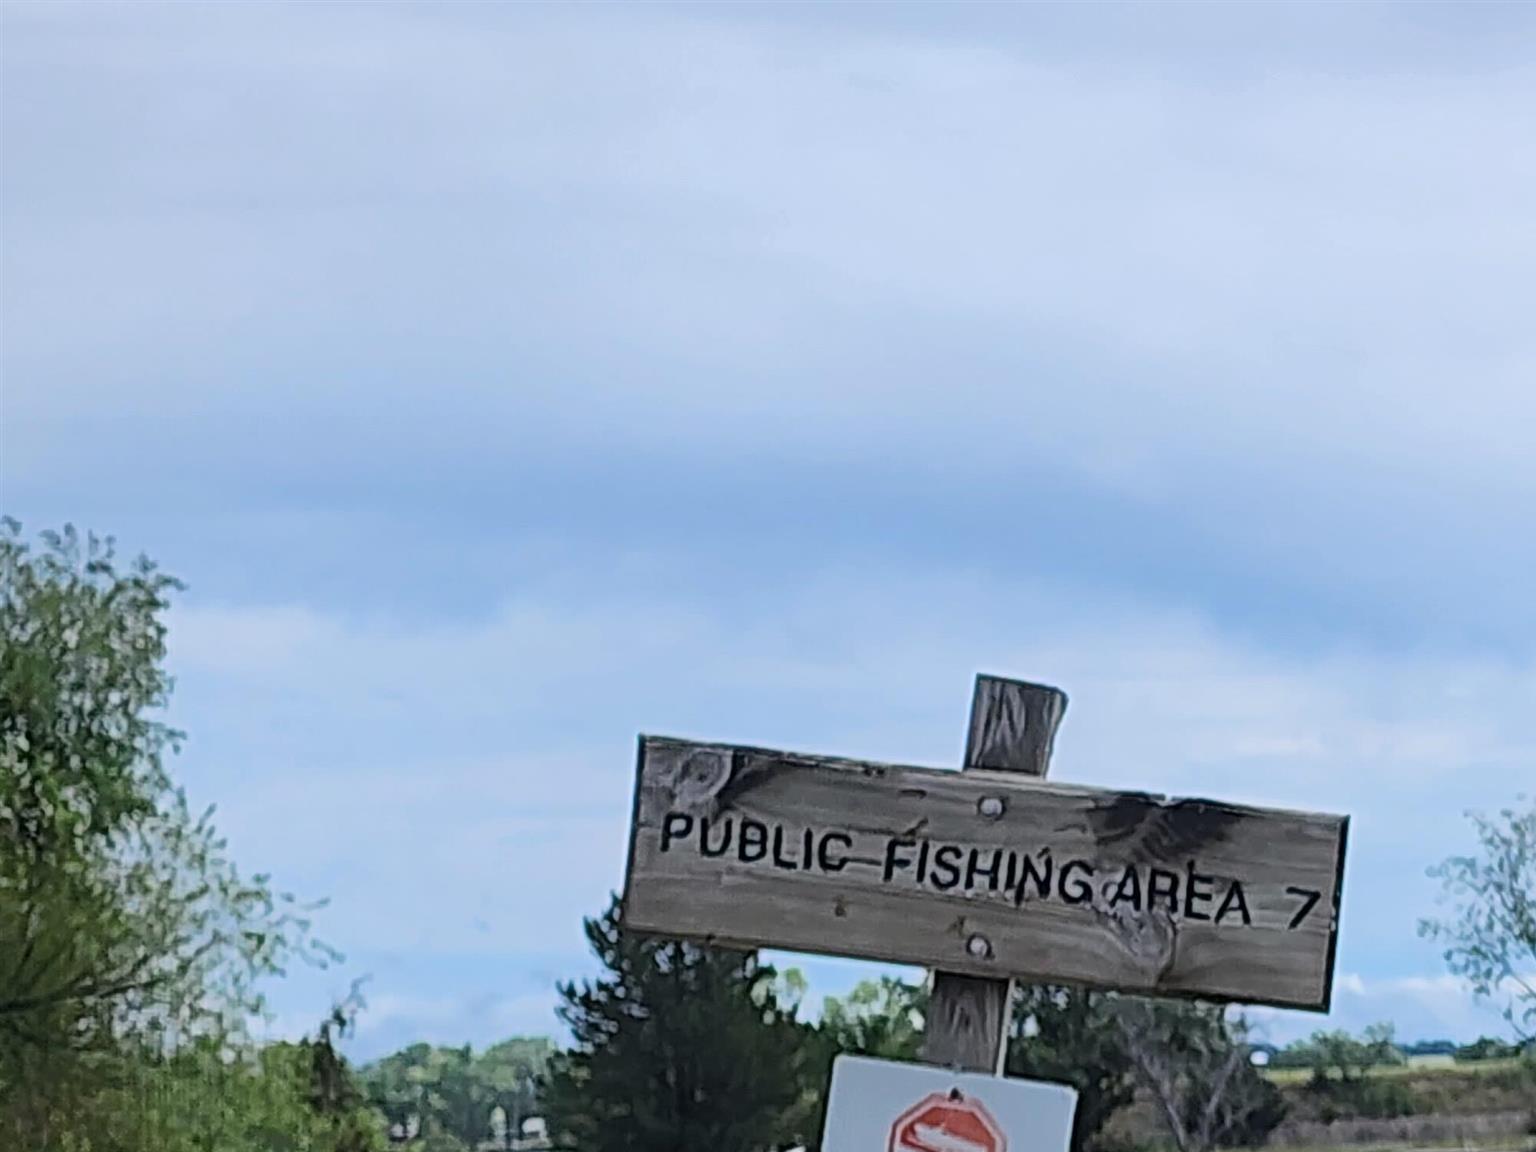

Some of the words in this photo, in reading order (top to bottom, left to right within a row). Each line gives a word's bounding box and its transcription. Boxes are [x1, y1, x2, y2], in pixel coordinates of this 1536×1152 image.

[660, 813, 854, 872] PUBLIC
[882, 838, 1094, 906] FISHING
[1112, 860, 1252, 926] AREA
[1285, 885, 1321, 930] 7
